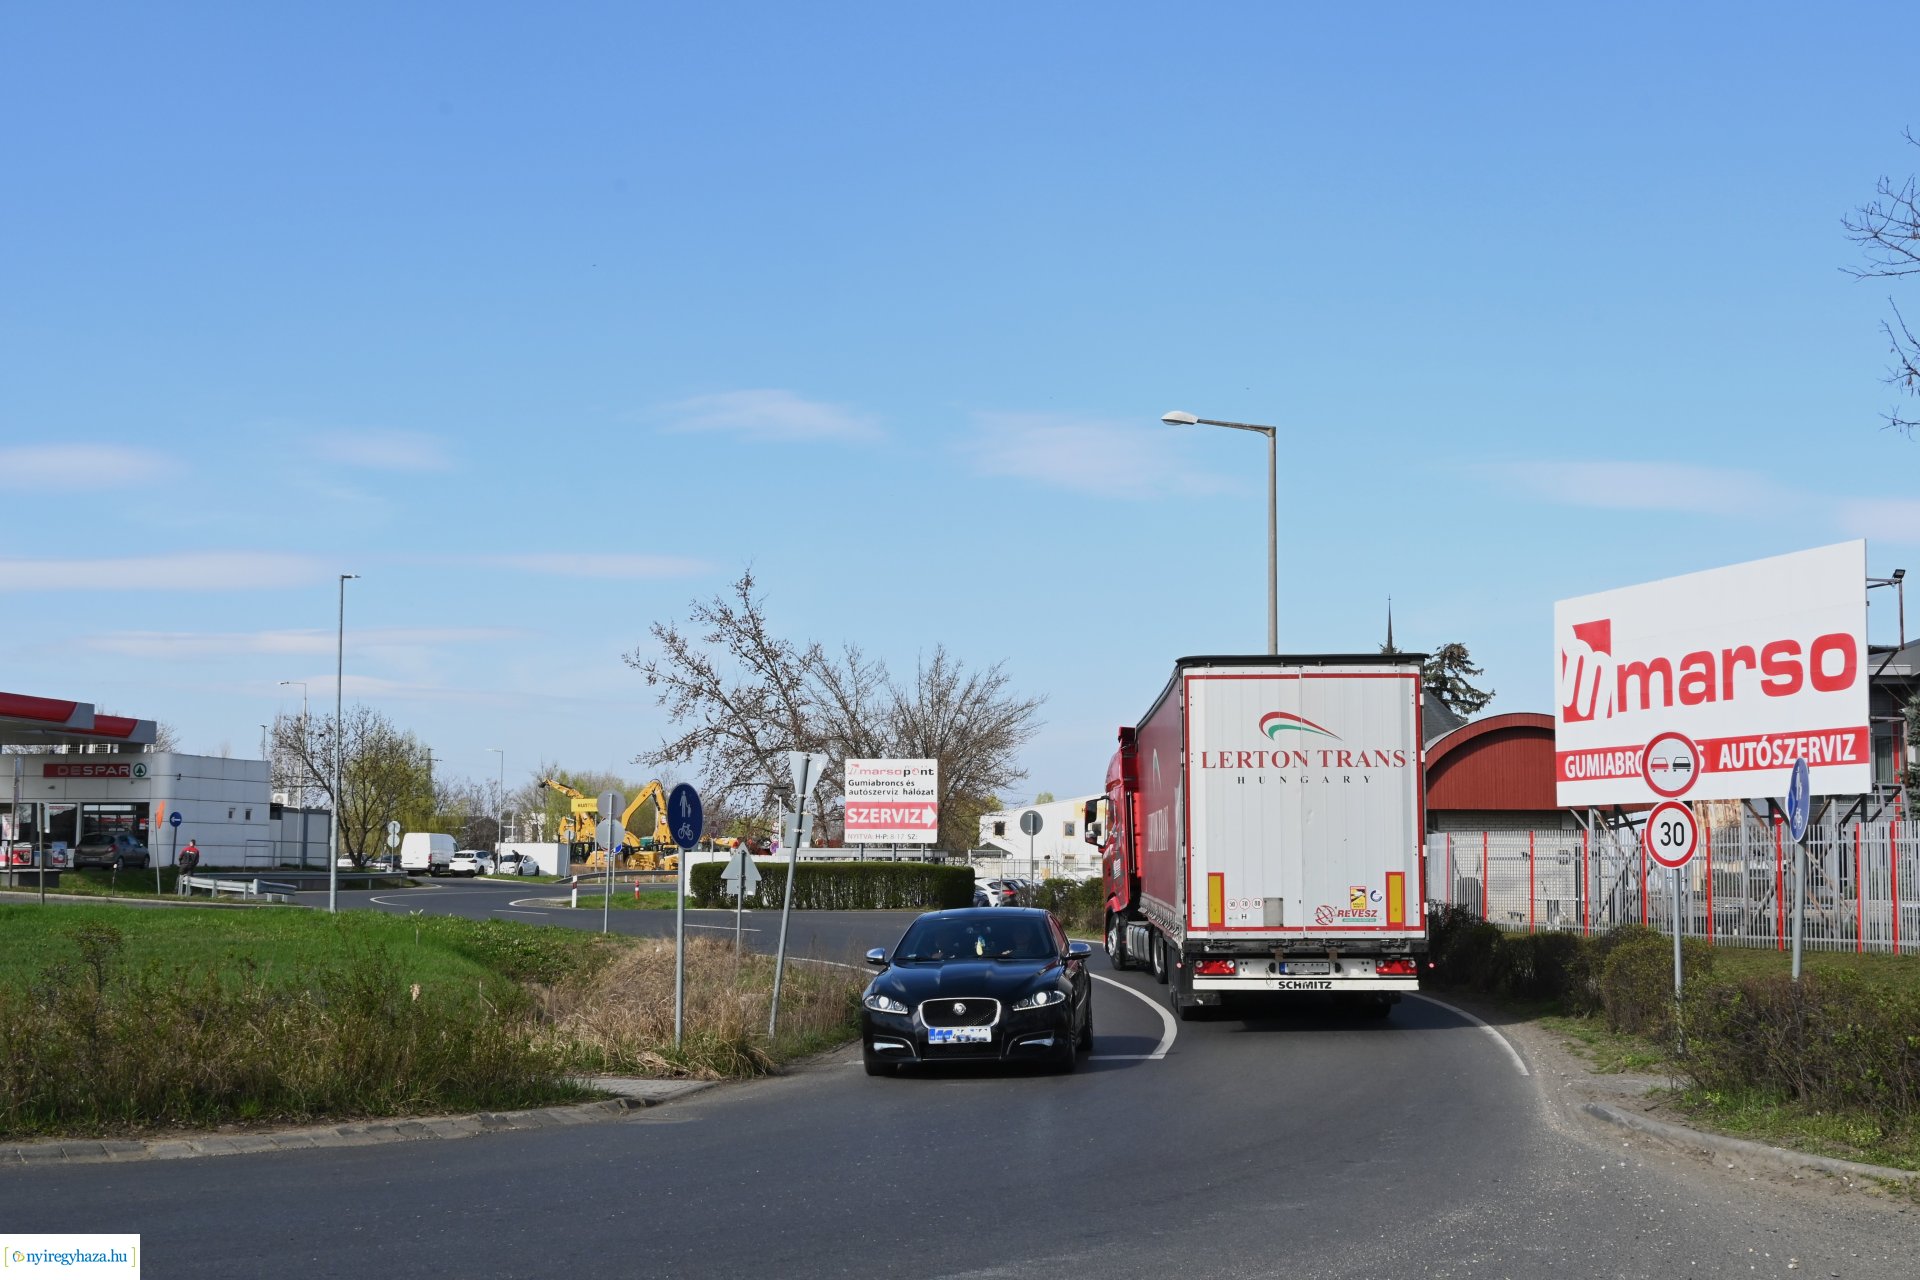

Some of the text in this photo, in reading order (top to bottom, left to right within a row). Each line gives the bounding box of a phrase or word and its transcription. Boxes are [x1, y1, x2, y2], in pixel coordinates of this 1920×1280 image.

[1617, 633, 1857, 713] marso
[1201, 749, 1407, 769] LERTON TRANS
[1565, 748, 1644, 779] GUMIABRO
[1718, 733, 1857, 770] AUTÓSZERVIZ
[57, 765, 130, 776] DESPAR
[848, 779, 904, 787] Gumiabroncs
[1237, 775, 1373, 785] HUNGARY
[847, 807, 921, 824] SZERVIZ
[1660, 821, 1685, 847] 30
[1278, 980, 1332, 989] SCHMITZ
